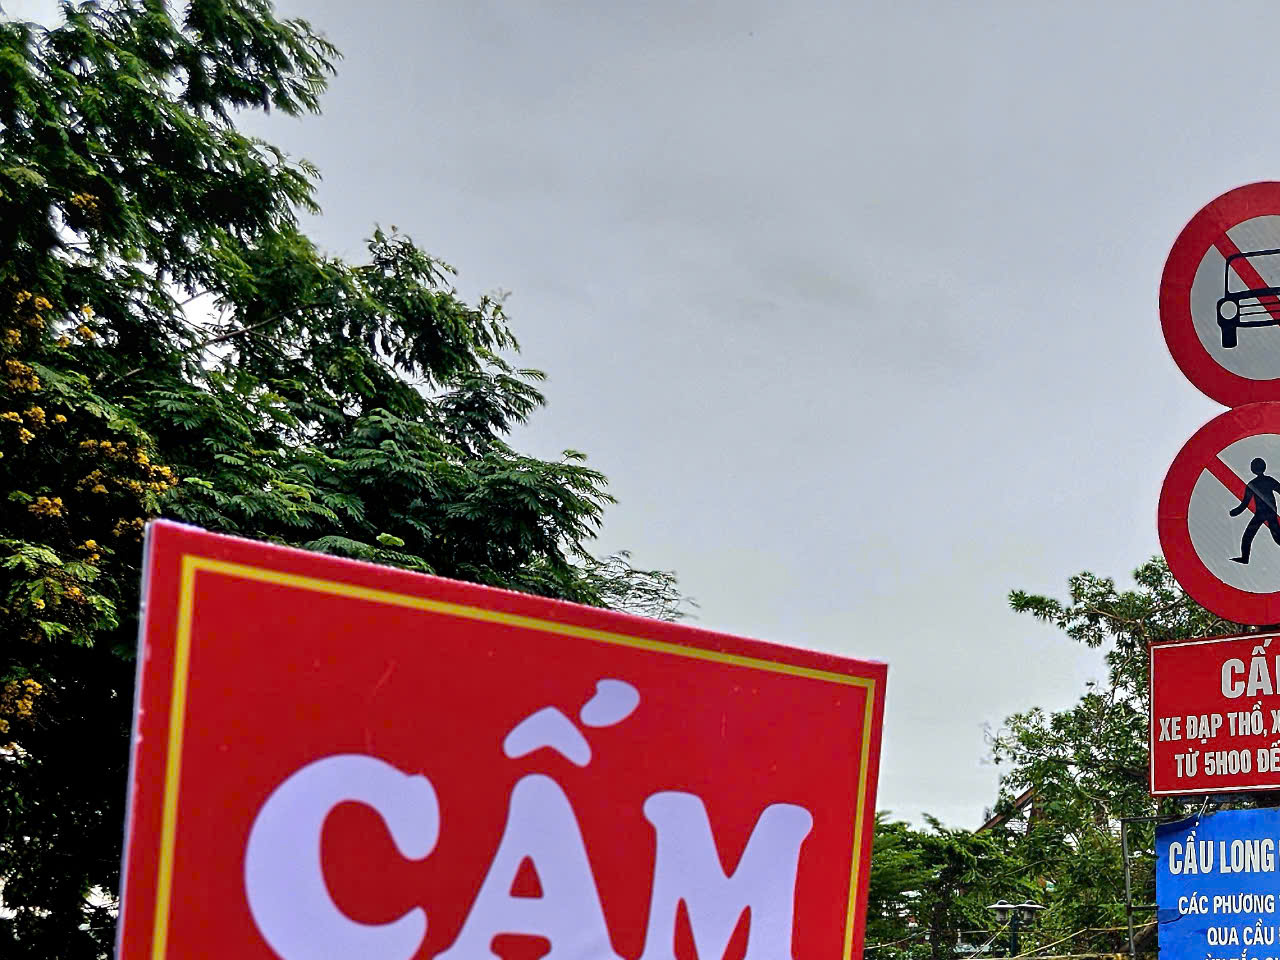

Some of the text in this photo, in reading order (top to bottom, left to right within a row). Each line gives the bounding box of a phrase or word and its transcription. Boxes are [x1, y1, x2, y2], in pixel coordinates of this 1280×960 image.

[1158, 716, 1182, 742] XE
[1185, 713, 1223, 745] ĐẠP
[1227, 700, 1268, 738] THỒ,
[1175, 748, 1199, 778] TỪ
[1204, 749, 1251, 776] 5H00
[1168, 830, 1214, 875] CẦU
[1219, 838, 1275, 874] LONG
[1178, 891, 1209, 915] CÁC
[1213, 892, 1275, 914] PHƯƠNG
[1206, 926, 1240, 947] QUA
[1242, 918, 1274, 946] CẦU
